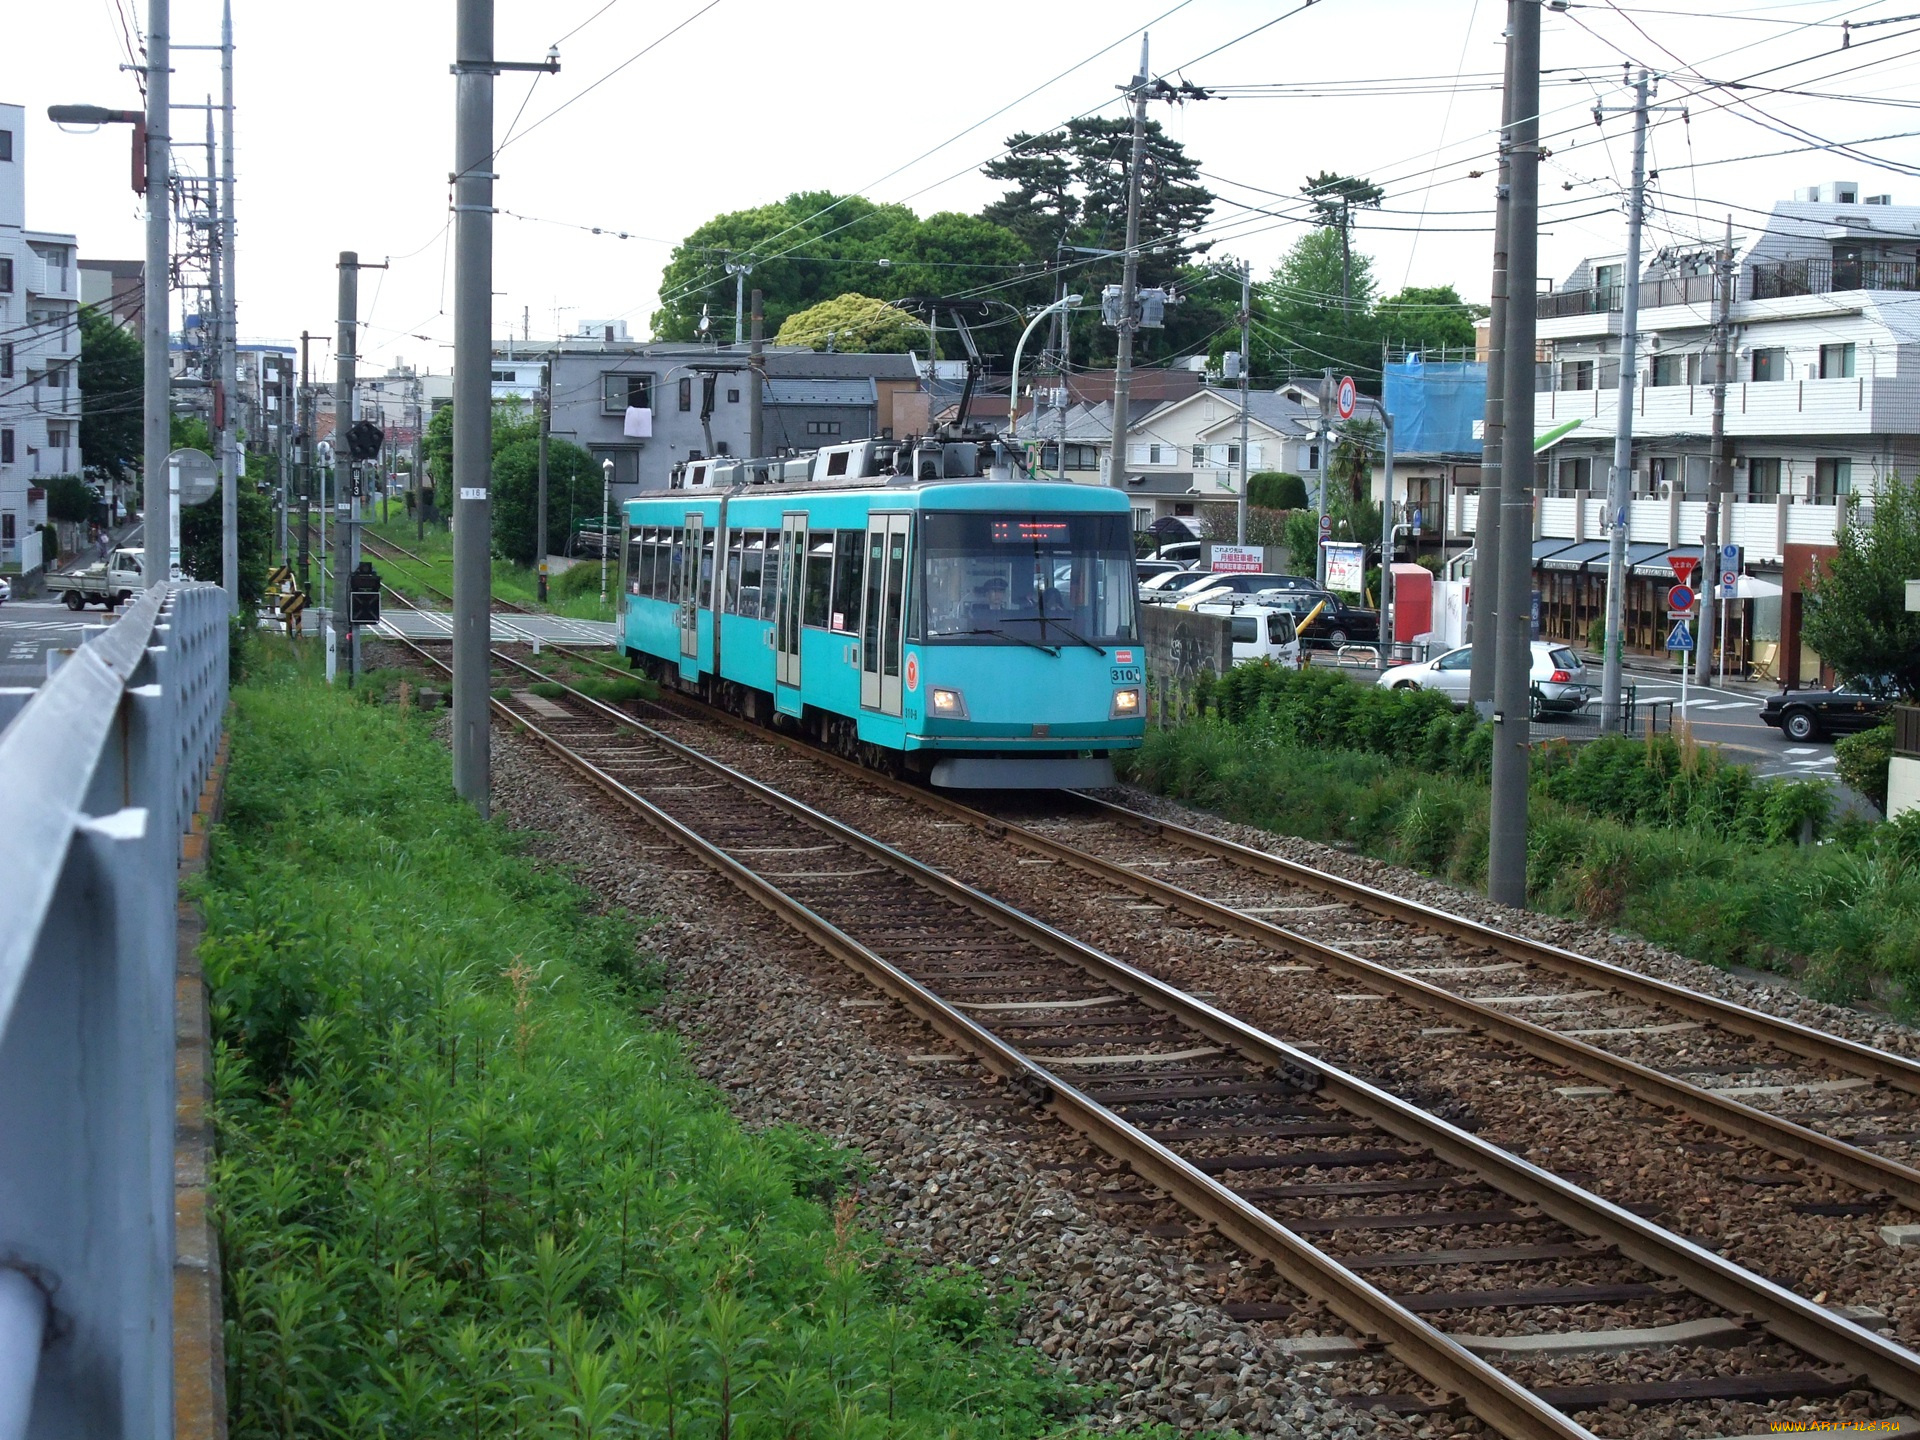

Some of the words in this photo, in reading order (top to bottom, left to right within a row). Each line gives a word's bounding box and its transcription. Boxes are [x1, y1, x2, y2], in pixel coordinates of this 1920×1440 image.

[1341, 389, 1352, 407] 40
[1221, 553, 1260, 562] 月極駐車場です
